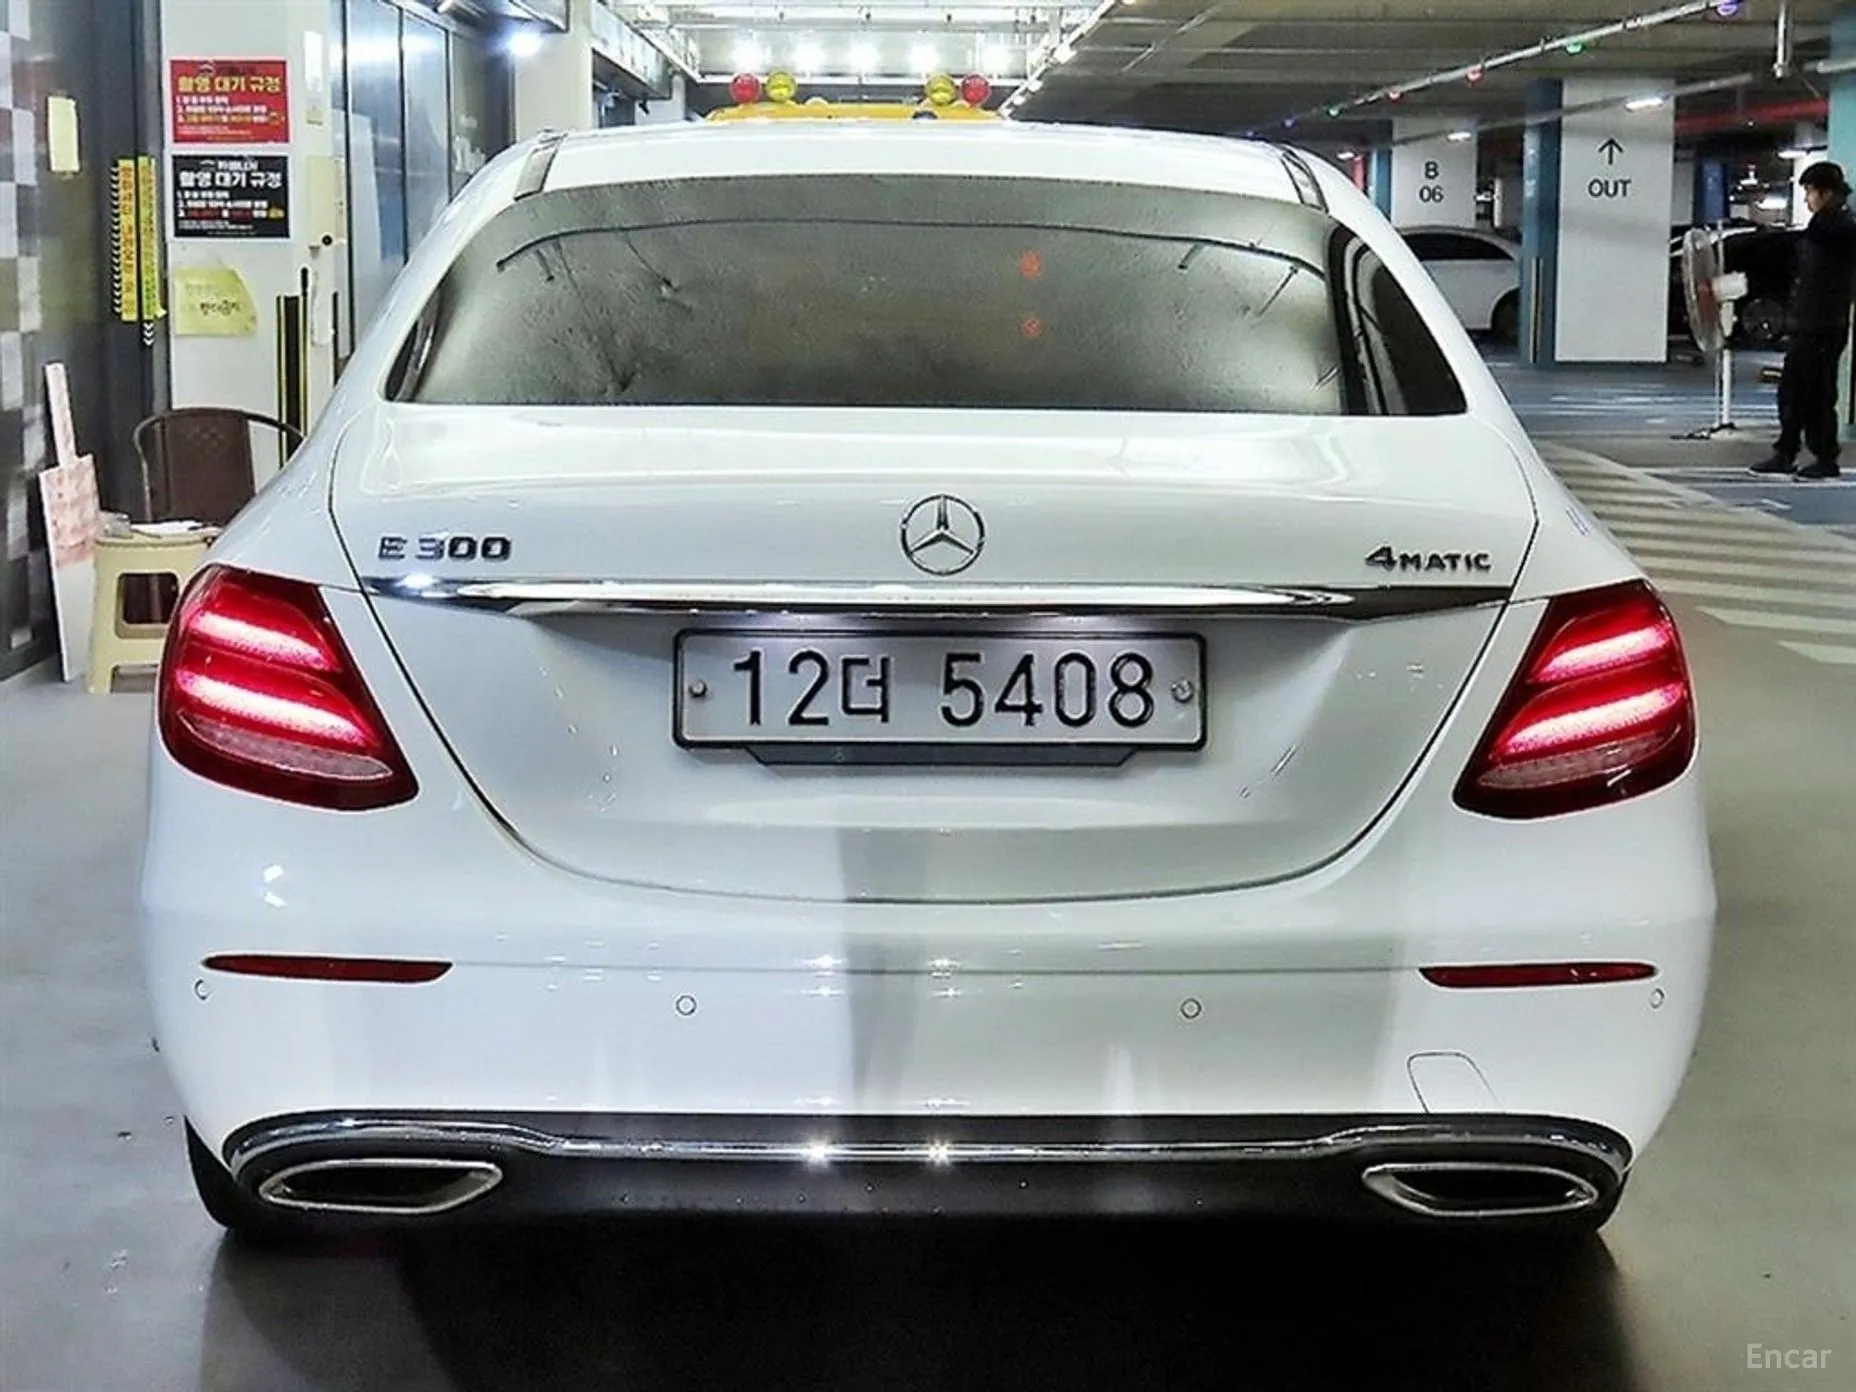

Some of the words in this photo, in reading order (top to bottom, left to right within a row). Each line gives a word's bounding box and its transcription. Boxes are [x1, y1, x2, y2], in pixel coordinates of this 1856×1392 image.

[214, 76, 247, 93] 대기
[215, 171, 247, 188] 대기
[1425, 162, 1439, 179] B
[1419, 186, 1444, 203] 06
[1588, 179, 1632, 198] OUT
[378, 536, 407, 560] E
[415, 536, 512, 561] 300
[1365, 546, 1492, 572] 4MATIC
[733, 649, 890, 727] 12더
[940, 651, 1154, 729] 5408
